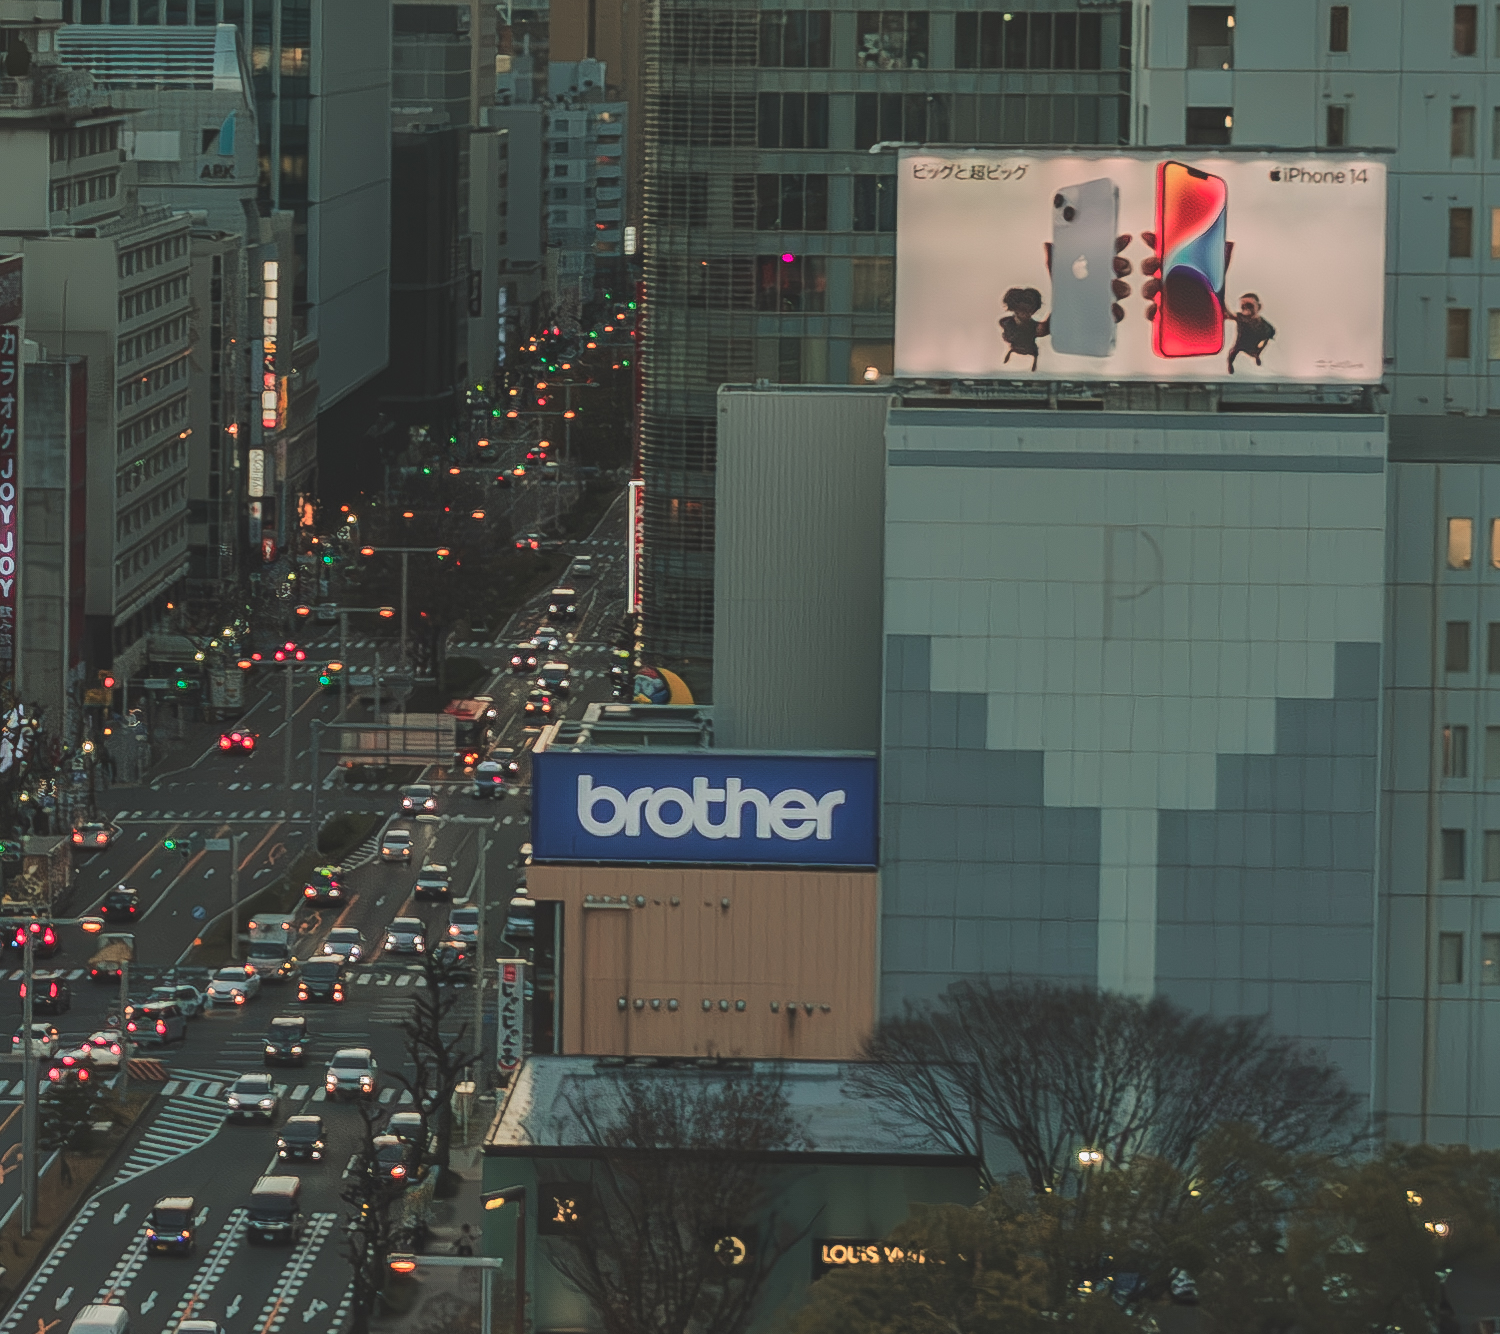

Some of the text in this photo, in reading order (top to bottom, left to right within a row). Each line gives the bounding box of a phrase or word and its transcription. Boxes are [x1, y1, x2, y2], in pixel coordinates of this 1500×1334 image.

[912, 163, 1029, 181] ビッグと超ビッグ
[1283, 168, 1368, 184] iPhone 14
[0, 329, 15, 449] カラオケ
[577, 774, 846, 841] brother
